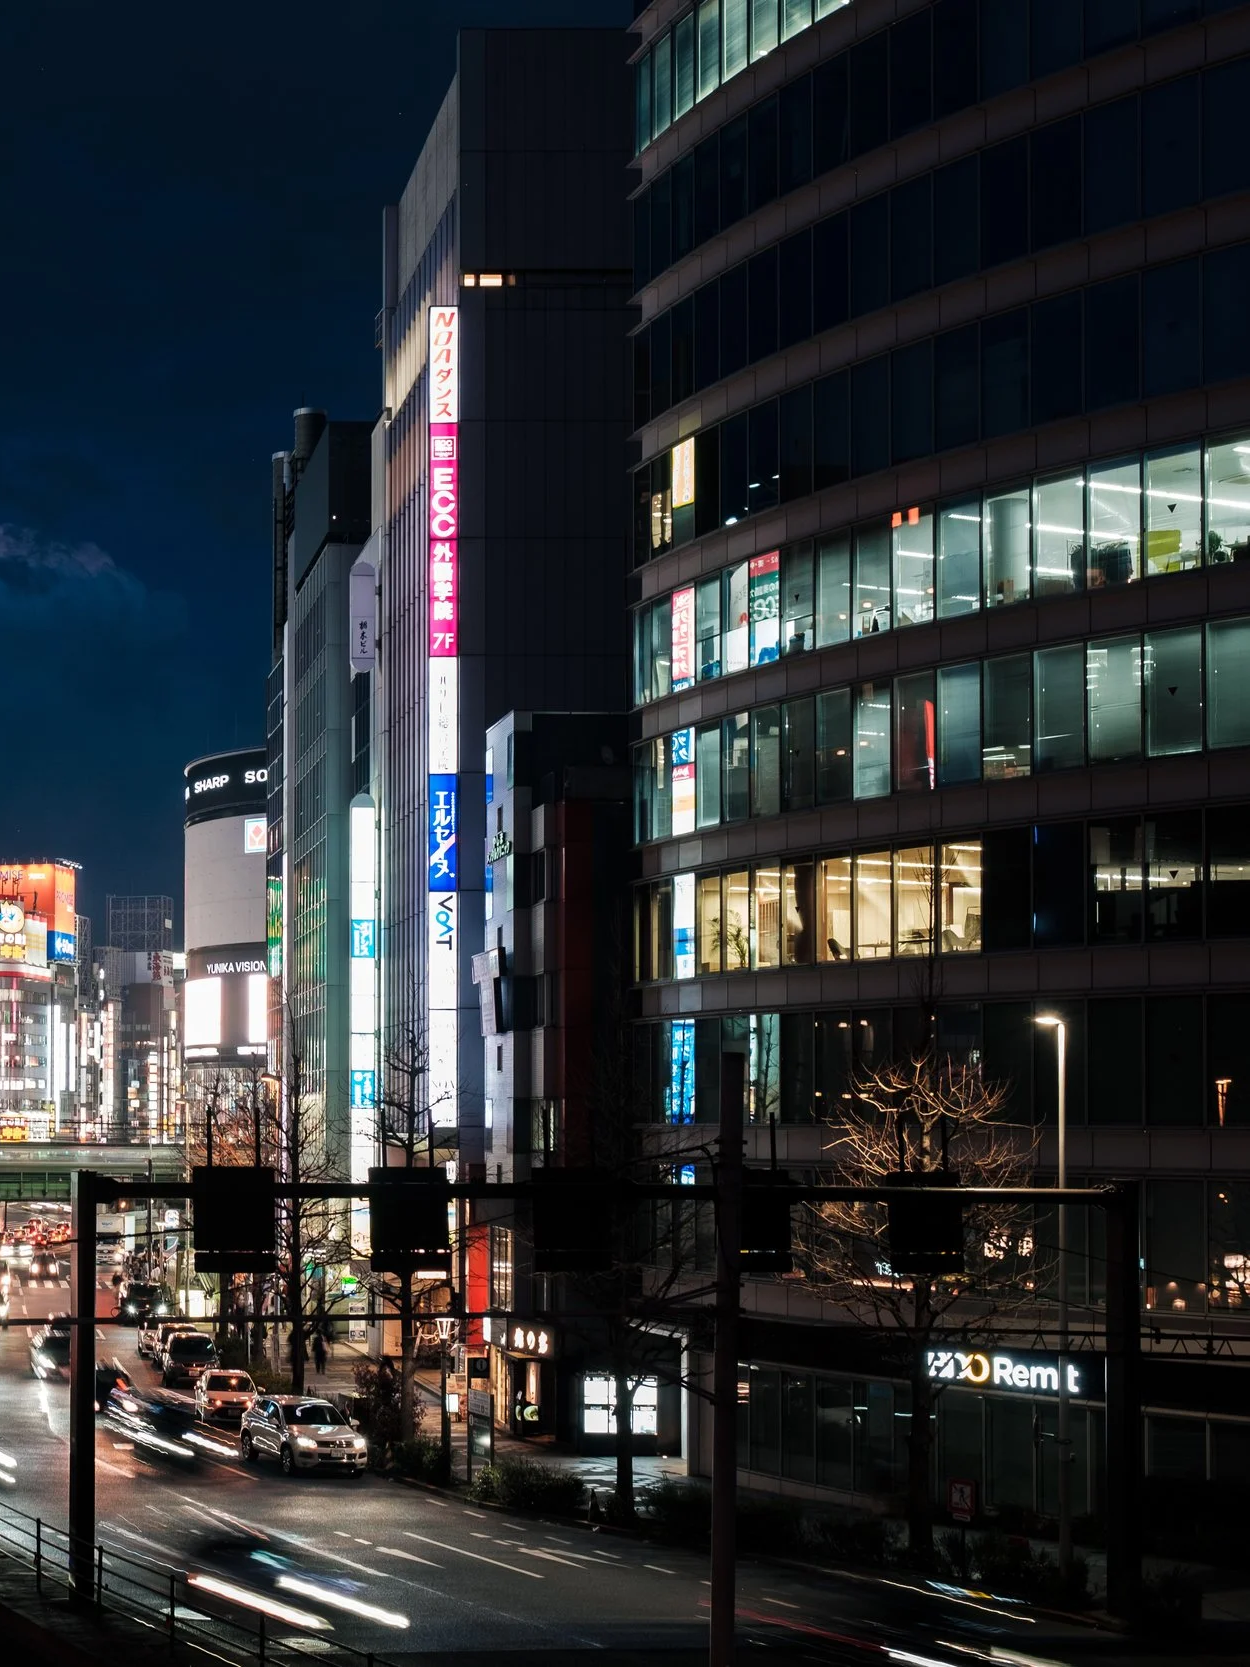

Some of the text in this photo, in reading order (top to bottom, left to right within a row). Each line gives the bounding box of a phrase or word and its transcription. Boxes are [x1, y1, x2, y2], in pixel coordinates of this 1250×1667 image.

[432, 632, 455, 650] 7F
[194, 774, 230, 794] SHARP
[207, 960, 267, 975] YUNIKA VISION
[993, 1356, 1080, 1393] Remt
